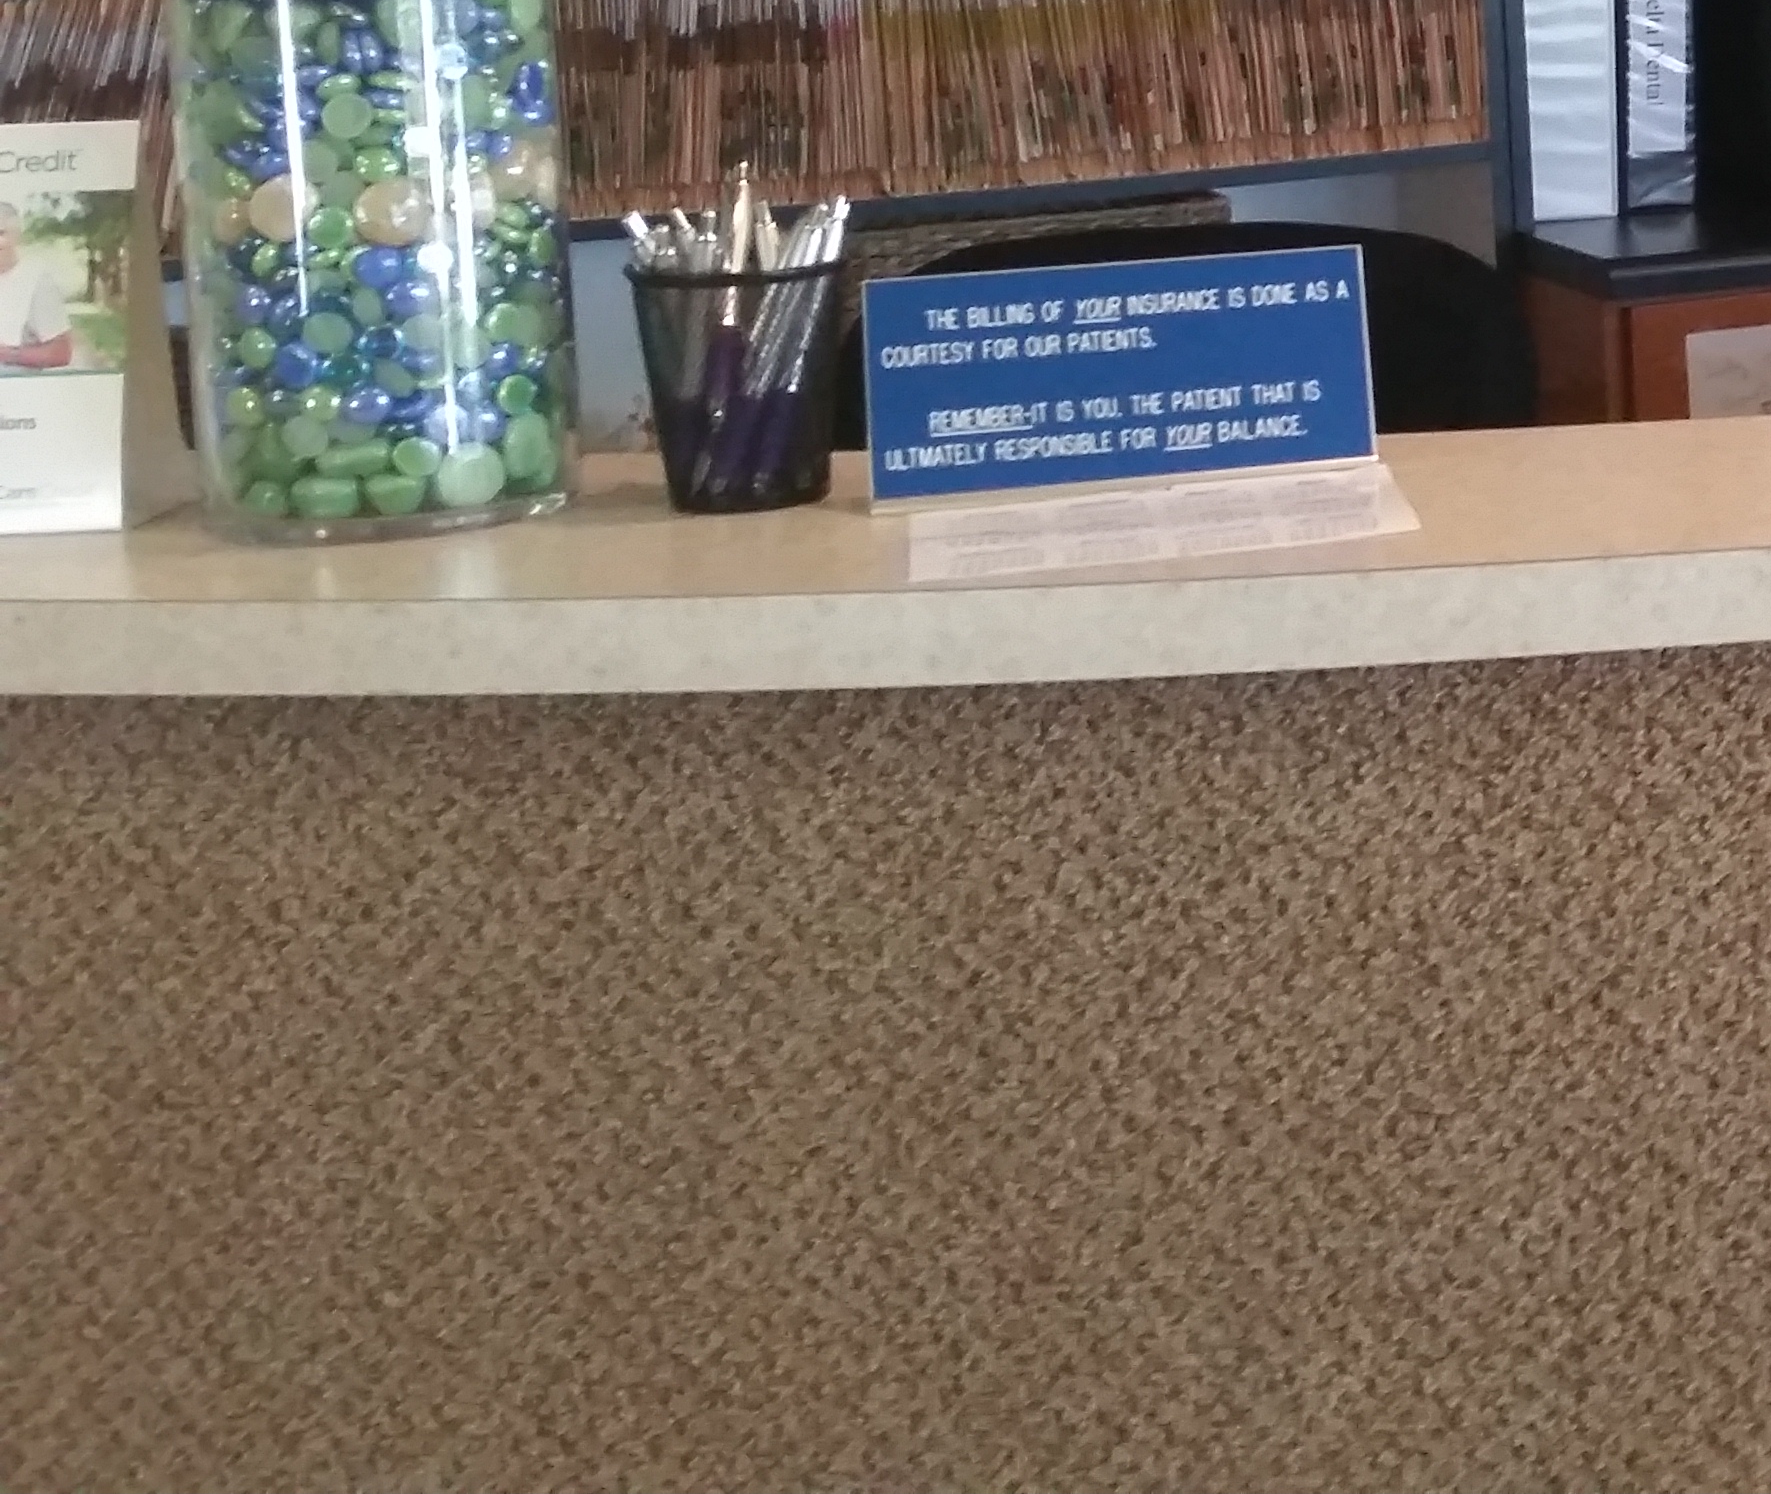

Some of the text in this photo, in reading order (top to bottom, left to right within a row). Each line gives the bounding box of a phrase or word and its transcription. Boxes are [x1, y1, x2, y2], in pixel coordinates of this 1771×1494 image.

[925, 278, 1349, 331] THE BILLING OF YOUR INSURANCE IS DONE AS A
[881, 326, 1157, 369] COURTESY FOR OUR PATIENTS.
[1056, 400, 1074, 423] IS
[1129, 391, 1165, 416] THE
[1170, 385, 1242, 413] PATIENT
[1251, 380, 1296, 406] THAT
[1302, 378, 1322, 403] IS
[884, 442, 988, 472] ULTIMATELY
[994, 430, 1114, 462] RESPONSIBLE
[1120, 426, 1157, 451] FOR
[1165, 421, 1213, 447] YOUR
